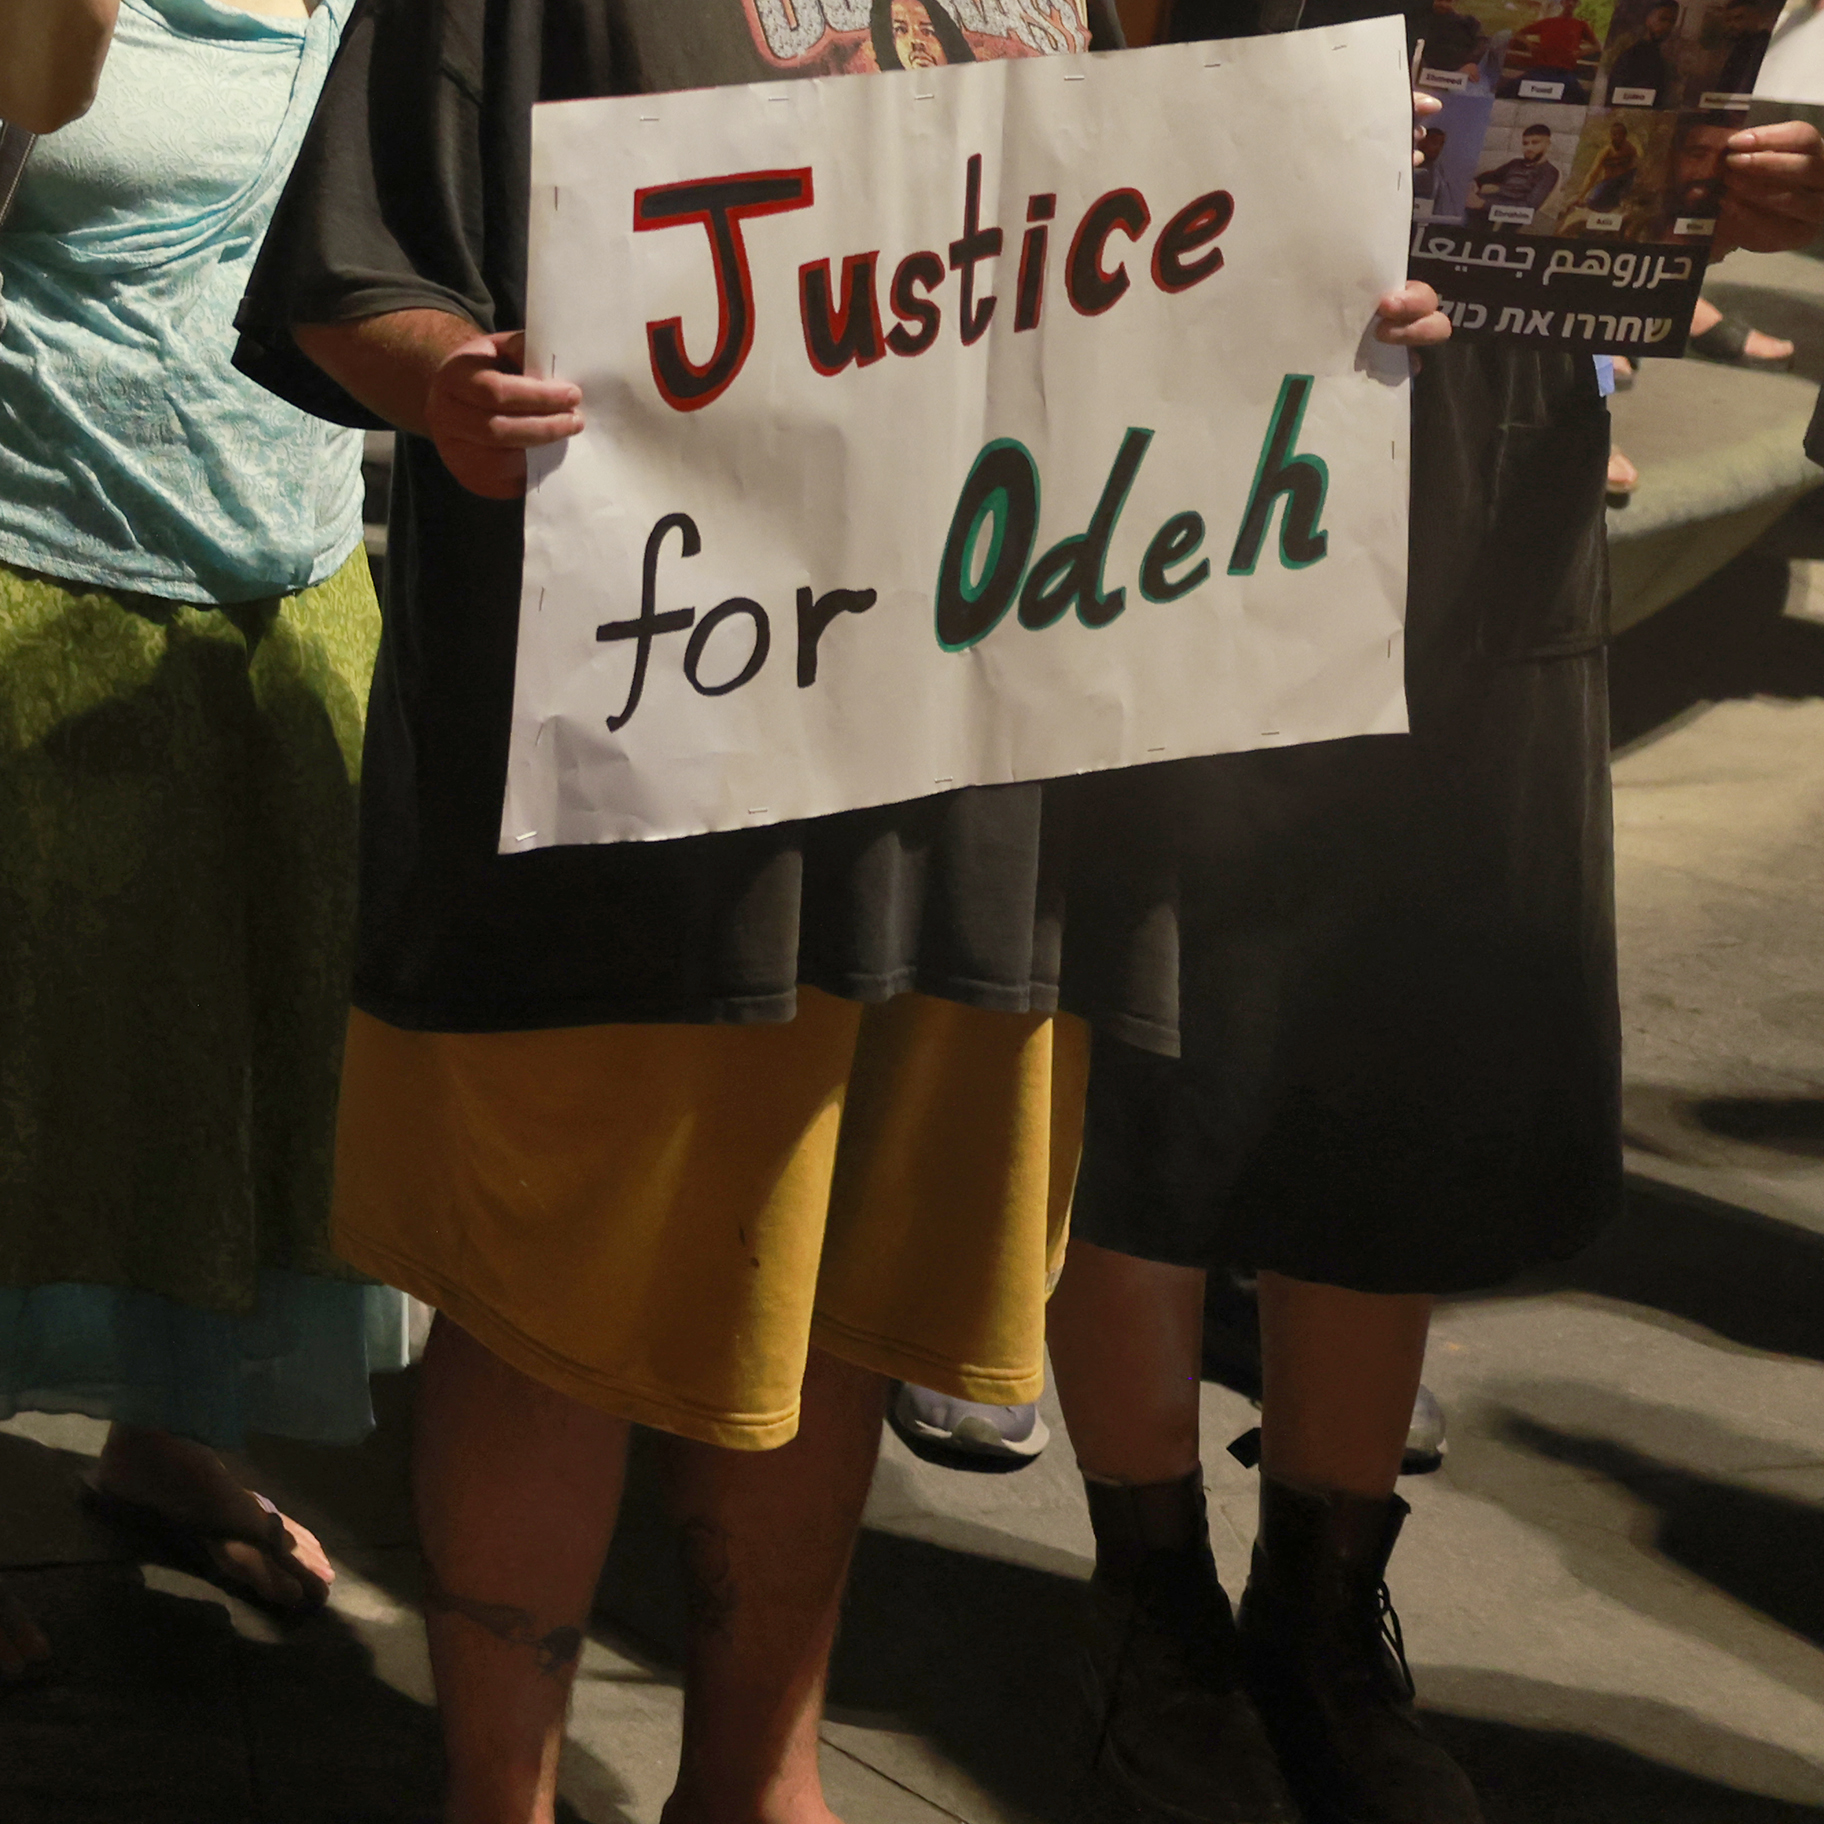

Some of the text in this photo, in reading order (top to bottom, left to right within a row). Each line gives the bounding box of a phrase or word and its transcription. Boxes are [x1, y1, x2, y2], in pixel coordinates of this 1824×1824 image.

[632, 152, 1236, 412] Justice
[1543, 247, 1694, 289] حرروهم
[1494, 304, 1557, 337] את
[1561, 309, 1673, 344] שחררו
[596, 373, 1330, 733] for Odeh
